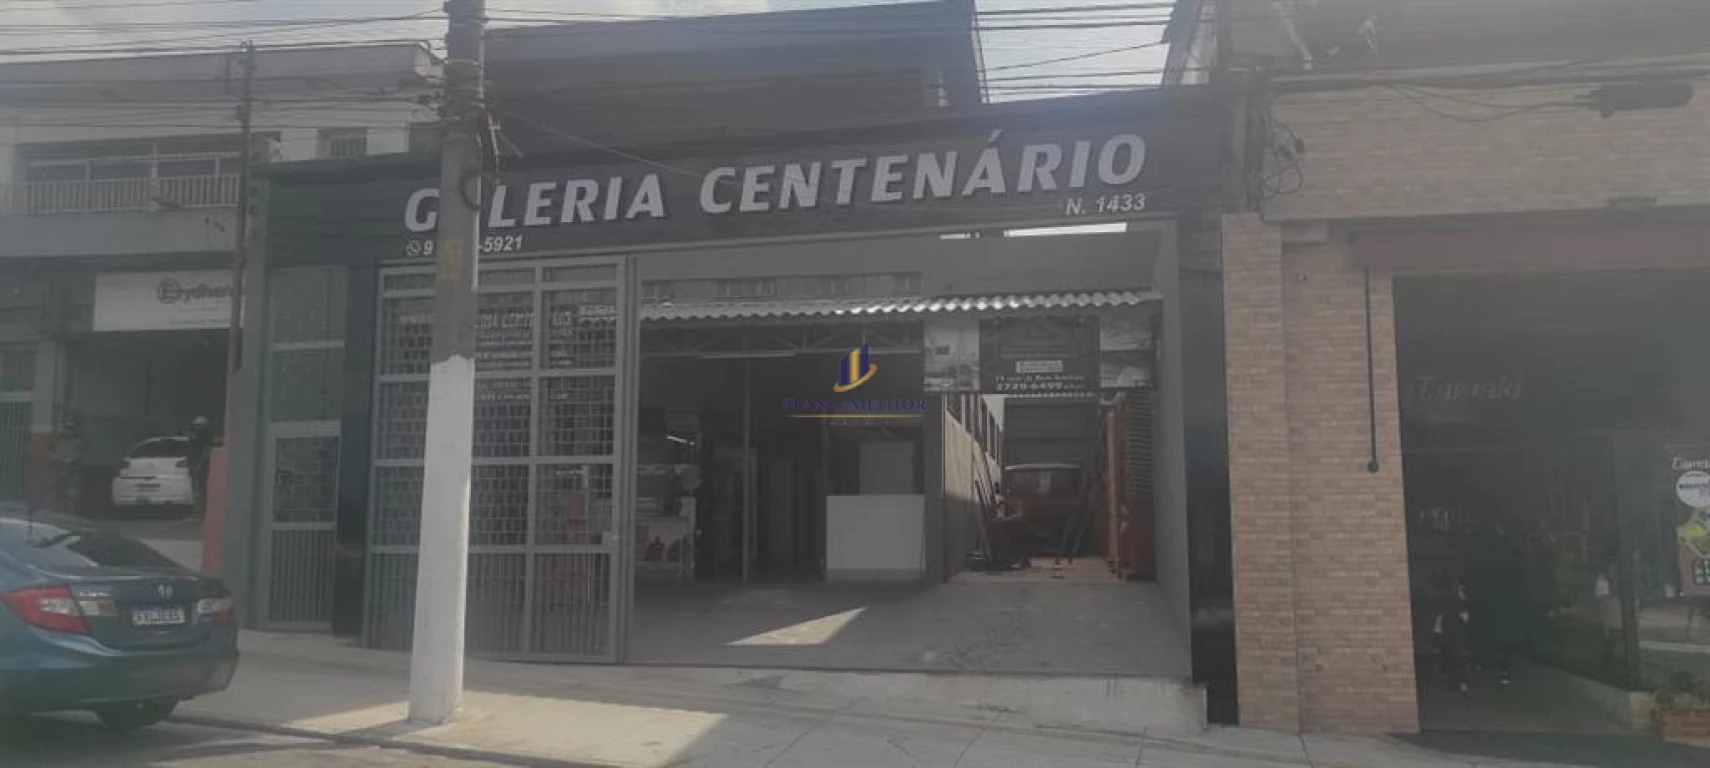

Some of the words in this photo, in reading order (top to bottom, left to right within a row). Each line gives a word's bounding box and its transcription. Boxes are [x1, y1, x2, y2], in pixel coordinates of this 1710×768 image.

[405, 174, 665, 232] GLERIA
[699, 127, 1147, 214] CENTENÁRIO
[1065, 198, 1087, 217] N.
[1095, 192, 1148, 214] 1433
